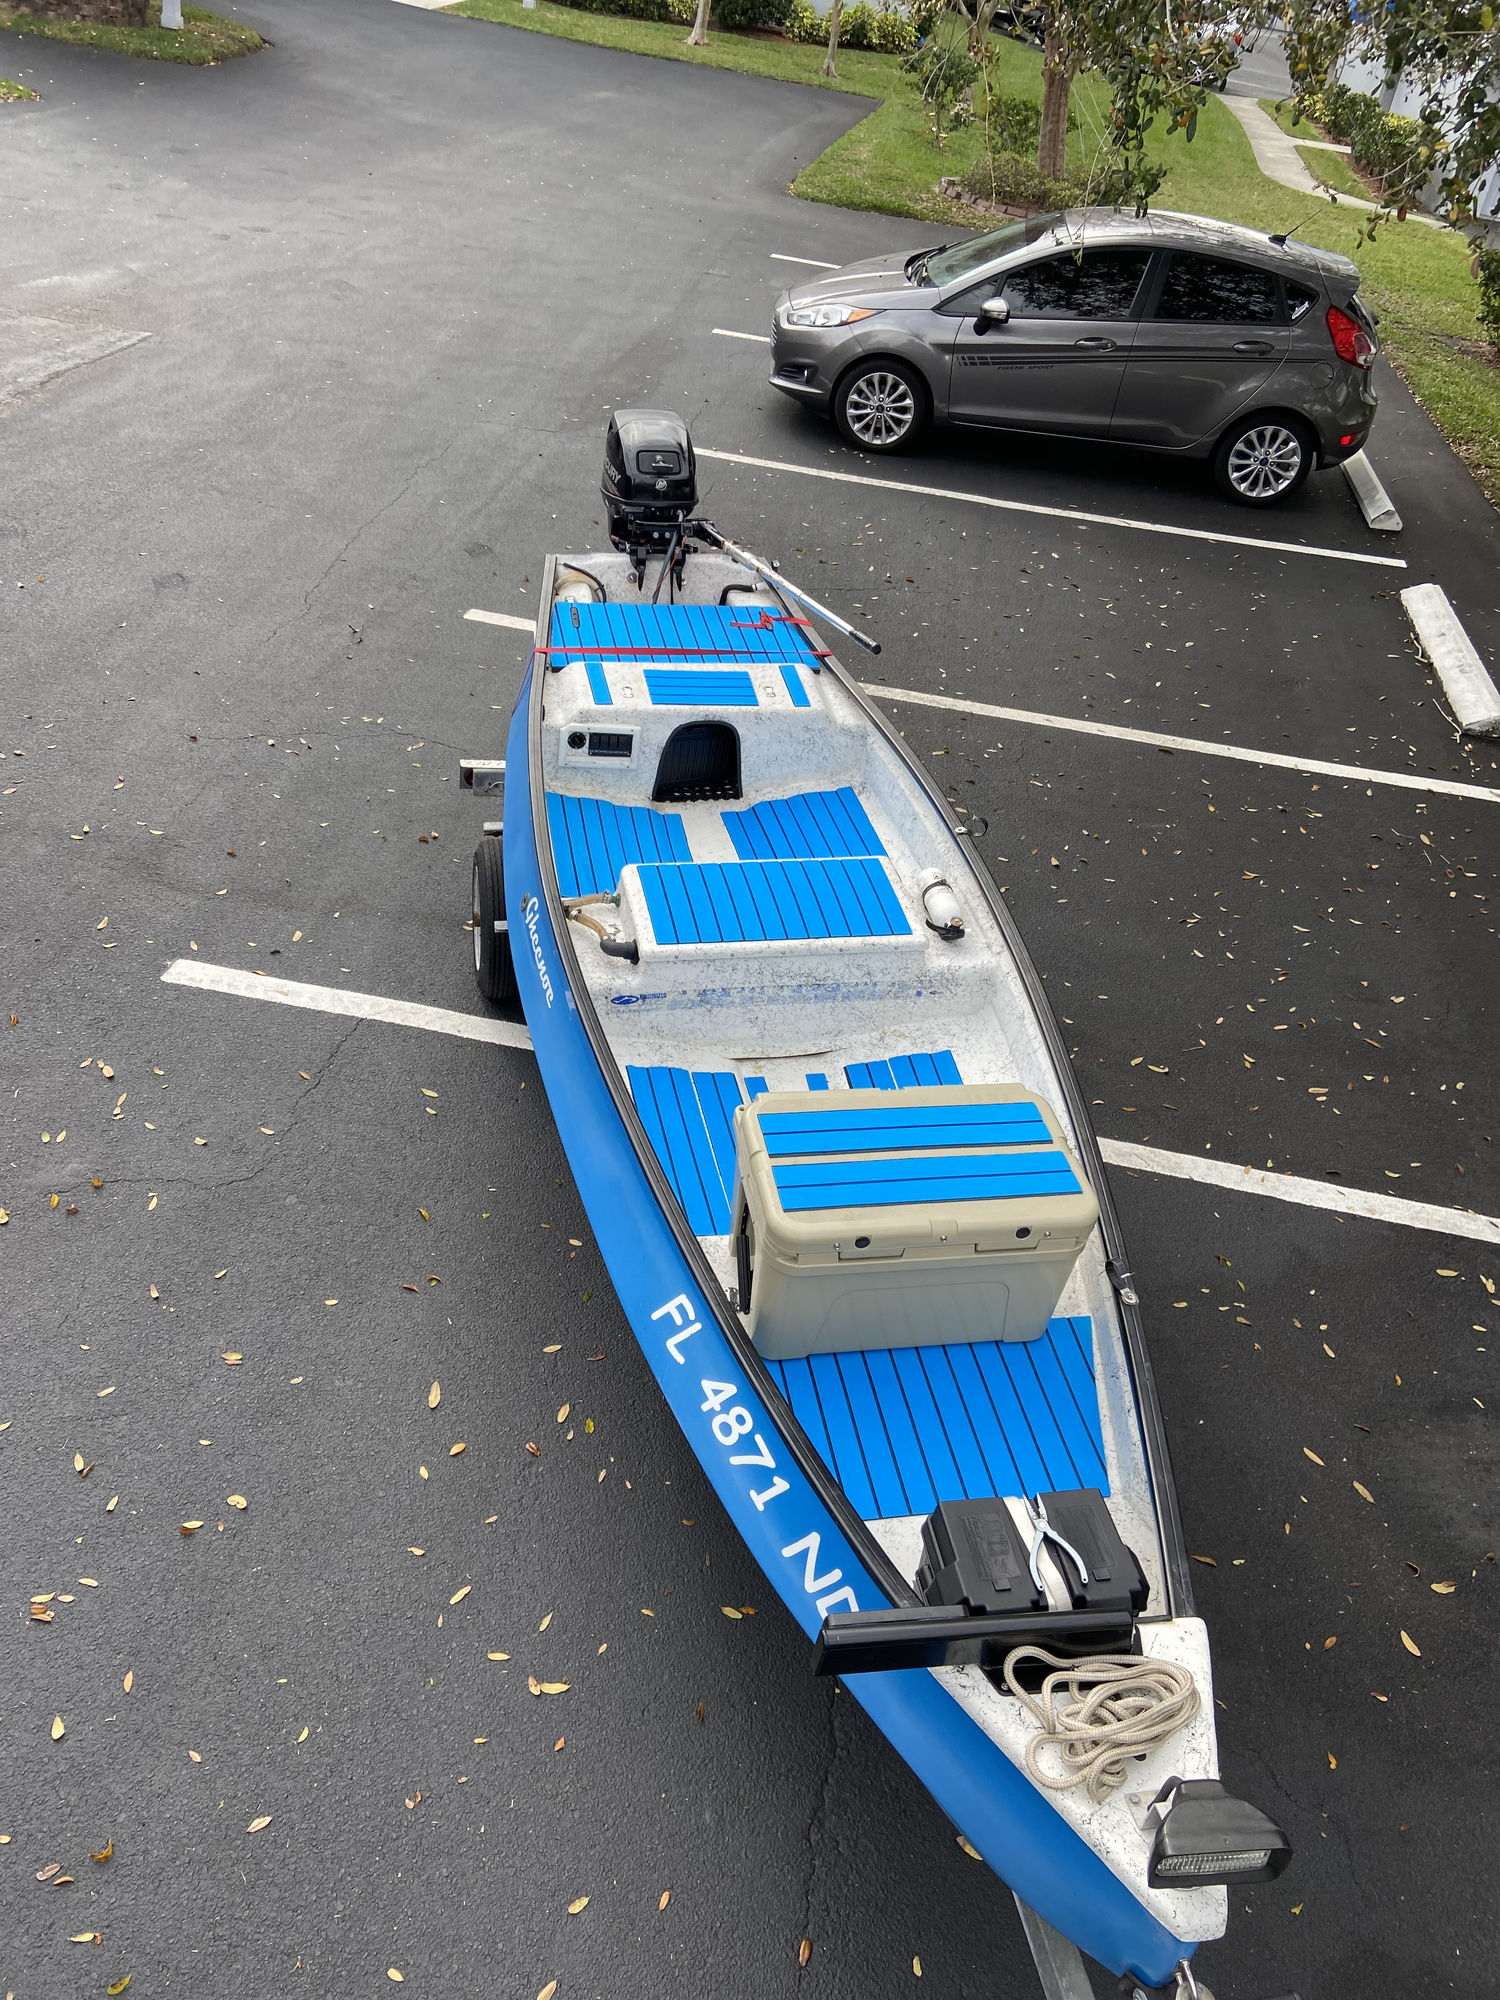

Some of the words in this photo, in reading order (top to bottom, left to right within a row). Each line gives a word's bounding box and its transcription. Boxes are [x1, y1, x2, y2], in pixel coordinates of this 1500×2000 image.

[604, 457, 622, 484] CURY
[650, 1293, 702, 1365] FL
[700, 1378, 790, 1512] 4871
